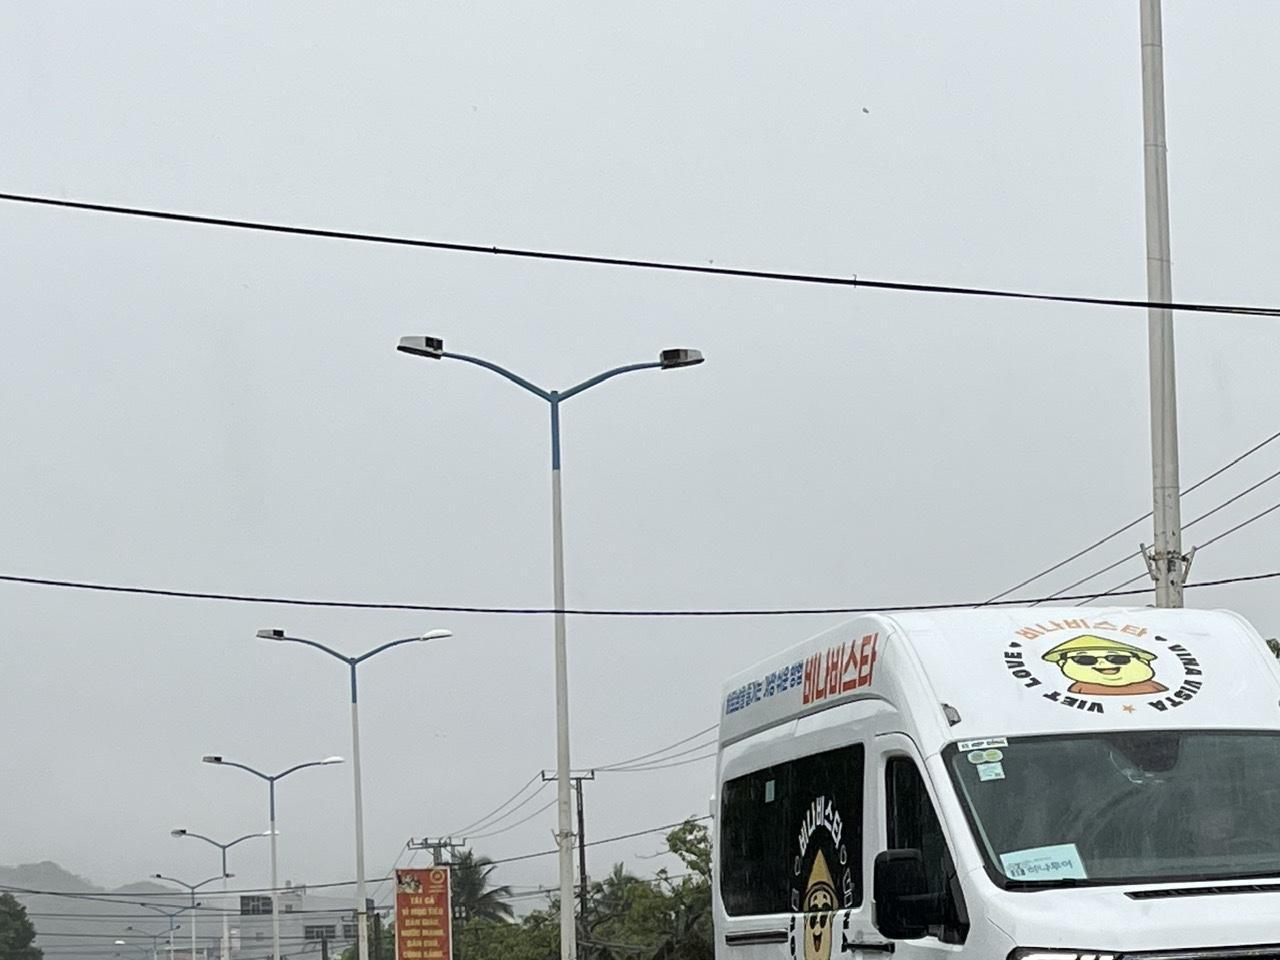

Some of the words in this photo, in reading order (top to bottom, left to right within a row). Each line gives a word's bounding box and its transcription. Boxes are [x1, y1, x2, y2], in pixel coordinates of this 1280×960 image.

[1014, 618, 1149, 641] 비나비스타
[803, 632, 879, 705] 비나비스타
[1004, 651, 1042, 688] LOVE
[1168, 644, 1203, 676] VINA
[1043, 690, 1105, 714] VIET
[1147, 679, 1203, 712] VISTA
[798, 795, 843, 857] 비나비스타
